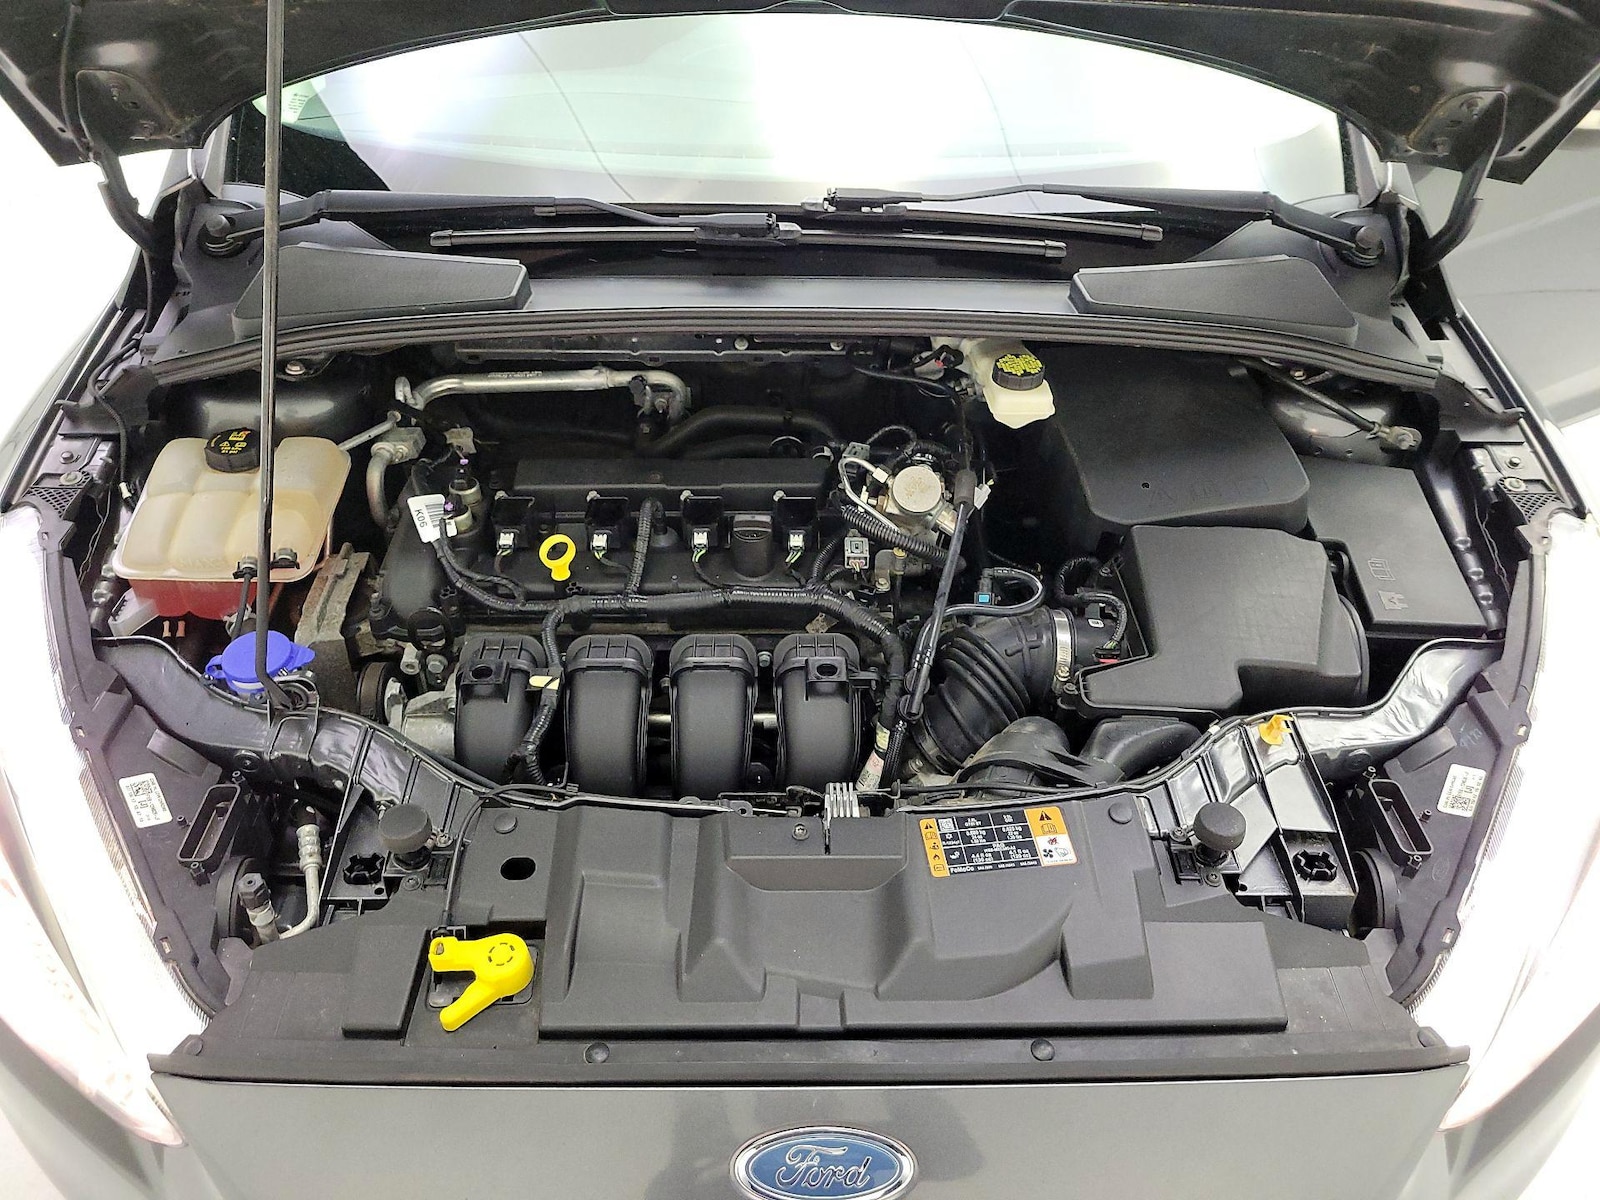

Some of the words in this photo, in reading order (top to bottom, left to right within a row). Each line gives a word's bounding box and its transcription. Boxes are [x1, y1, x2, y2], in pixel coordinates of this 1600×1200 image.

[415, 509, 428, 528] K06
[950, 865, 974, 873] FoMoCo
[775, 1144, 872, 1188] Ford
